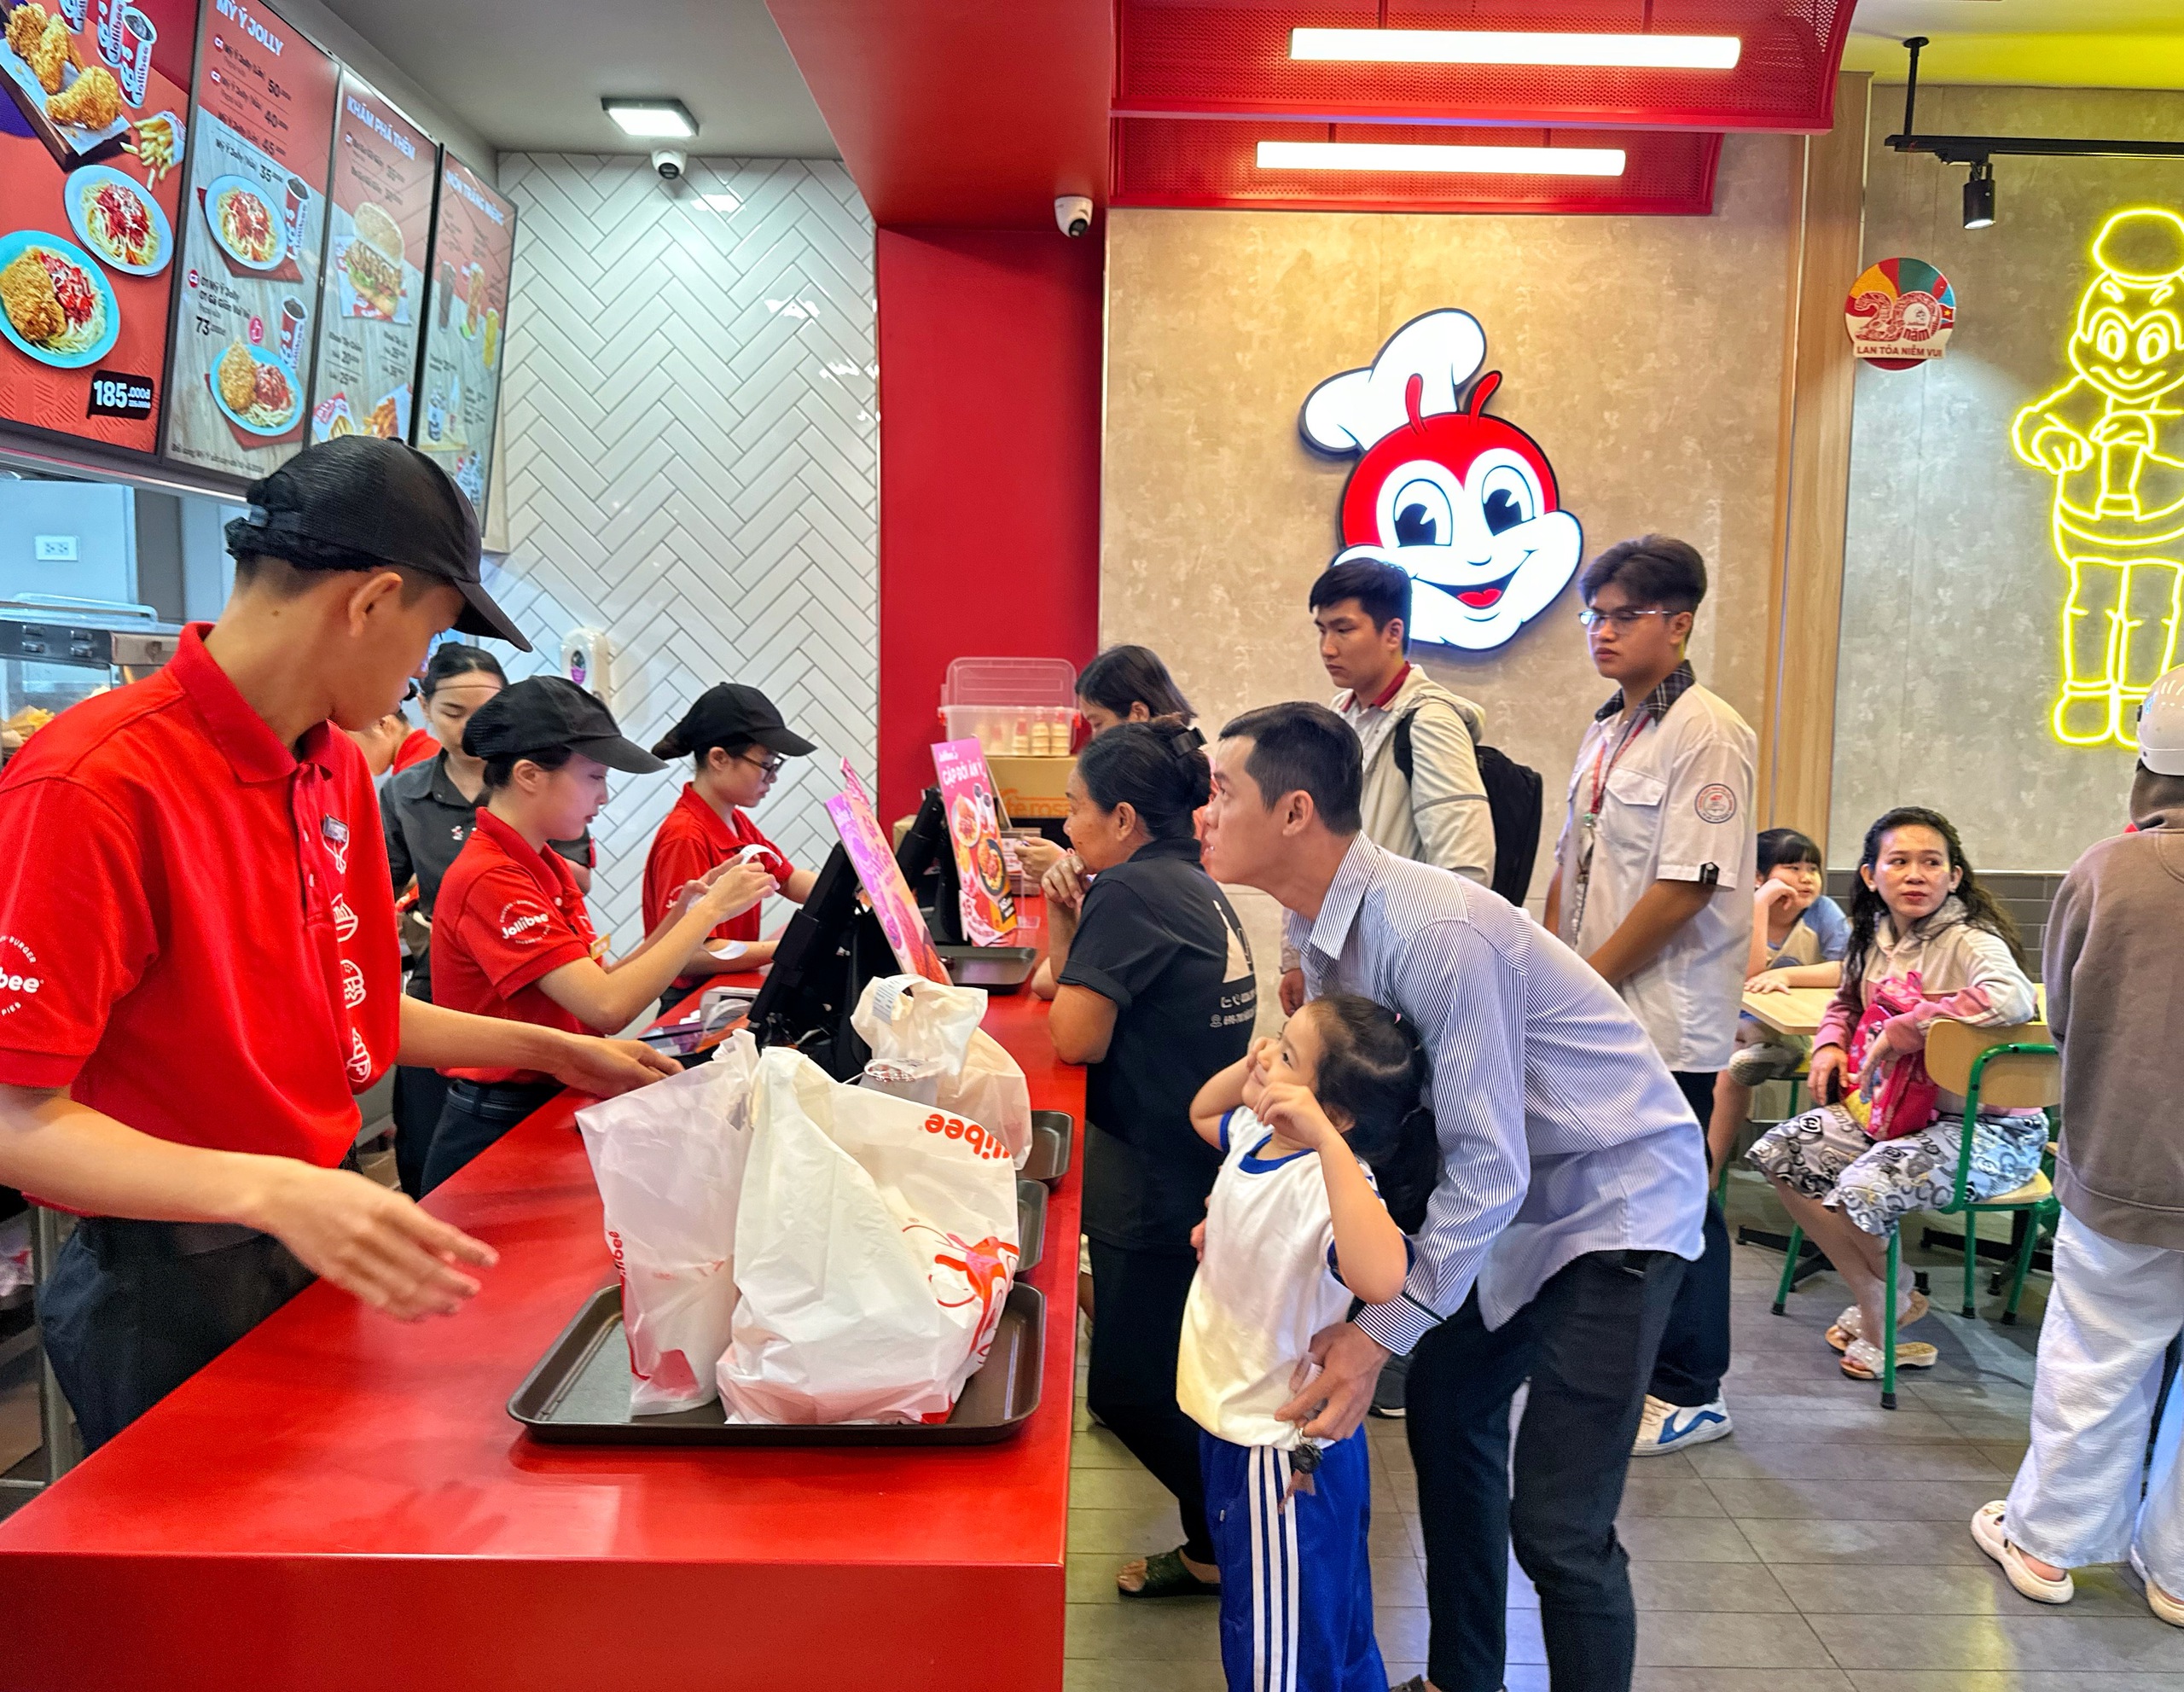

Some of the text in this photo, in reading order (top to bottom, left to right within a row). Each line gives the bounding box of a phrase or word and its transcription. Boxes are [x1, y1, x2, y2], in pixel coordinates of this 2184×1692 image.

[247, 17, 284, 56] JOLLY
[1856, 346, 1876, 354] LAN
[1927, 348, 1943, 358] VUI
[502, 913, 549, 939] Jollibee
[9, 935, 37, 963] BURGER
